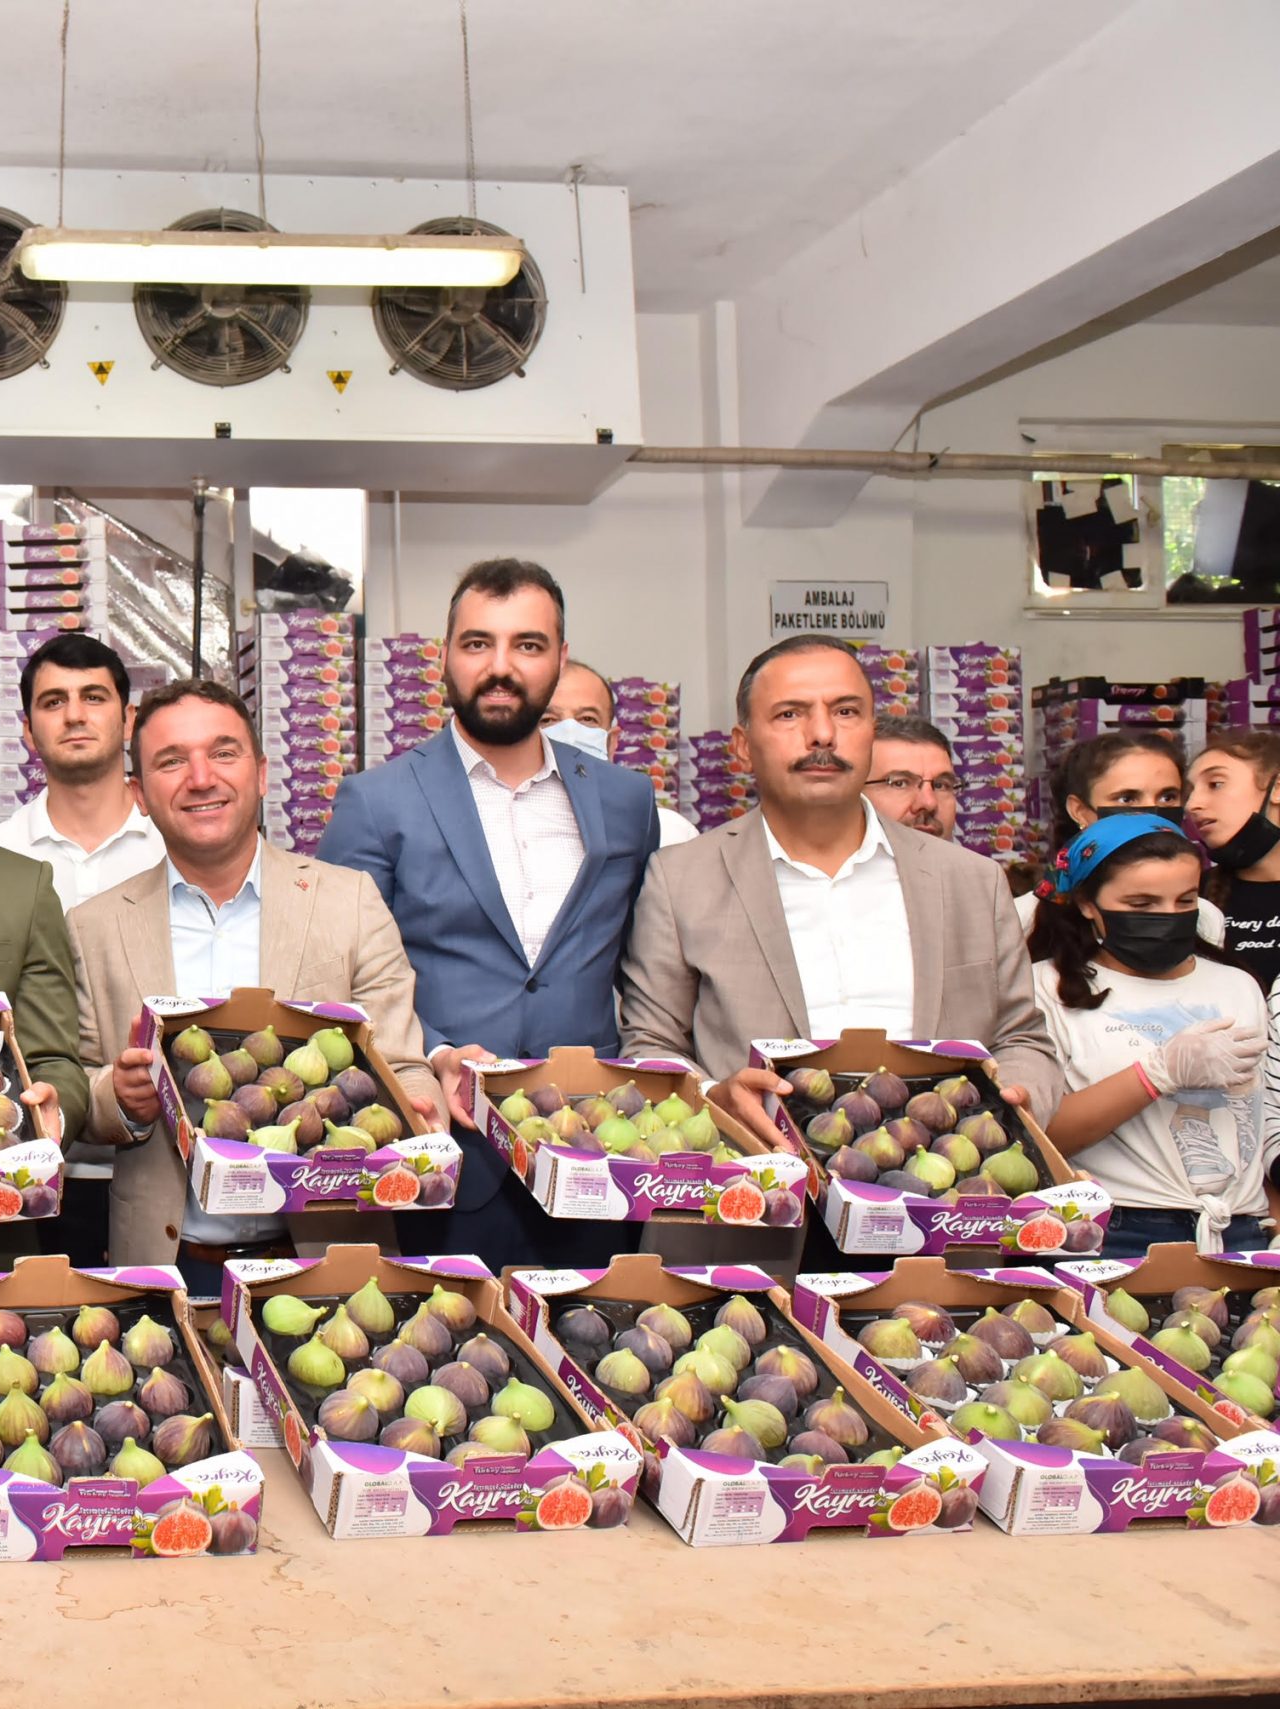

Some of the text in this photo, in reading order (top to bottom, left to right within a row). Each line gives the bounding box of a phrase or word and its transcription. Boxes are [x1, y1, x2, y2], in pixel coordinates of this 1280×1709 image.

[804, 591, 855, 606] AMBALAJ
[775, 610, 886, 629] PAKETLEME BÖLÜMÜ
[1224, 916, 1263, 932] Every
[1235, 939, 1276, 951] good
[291, 1166, 366, 1194] Kayra
[633, 1173, 711, 1206] Kayra
[930, 1211, 1009, 1241] Kayra
[575, 1442, 638, 1461] Kayra
[437, 1481, 524, 1517] Kayra
[793, 1483, 878, 1518] Kayra
[1110, 1477, 1196, 1512] Kayra
[41, 1502, 137, 1541] Kayra
